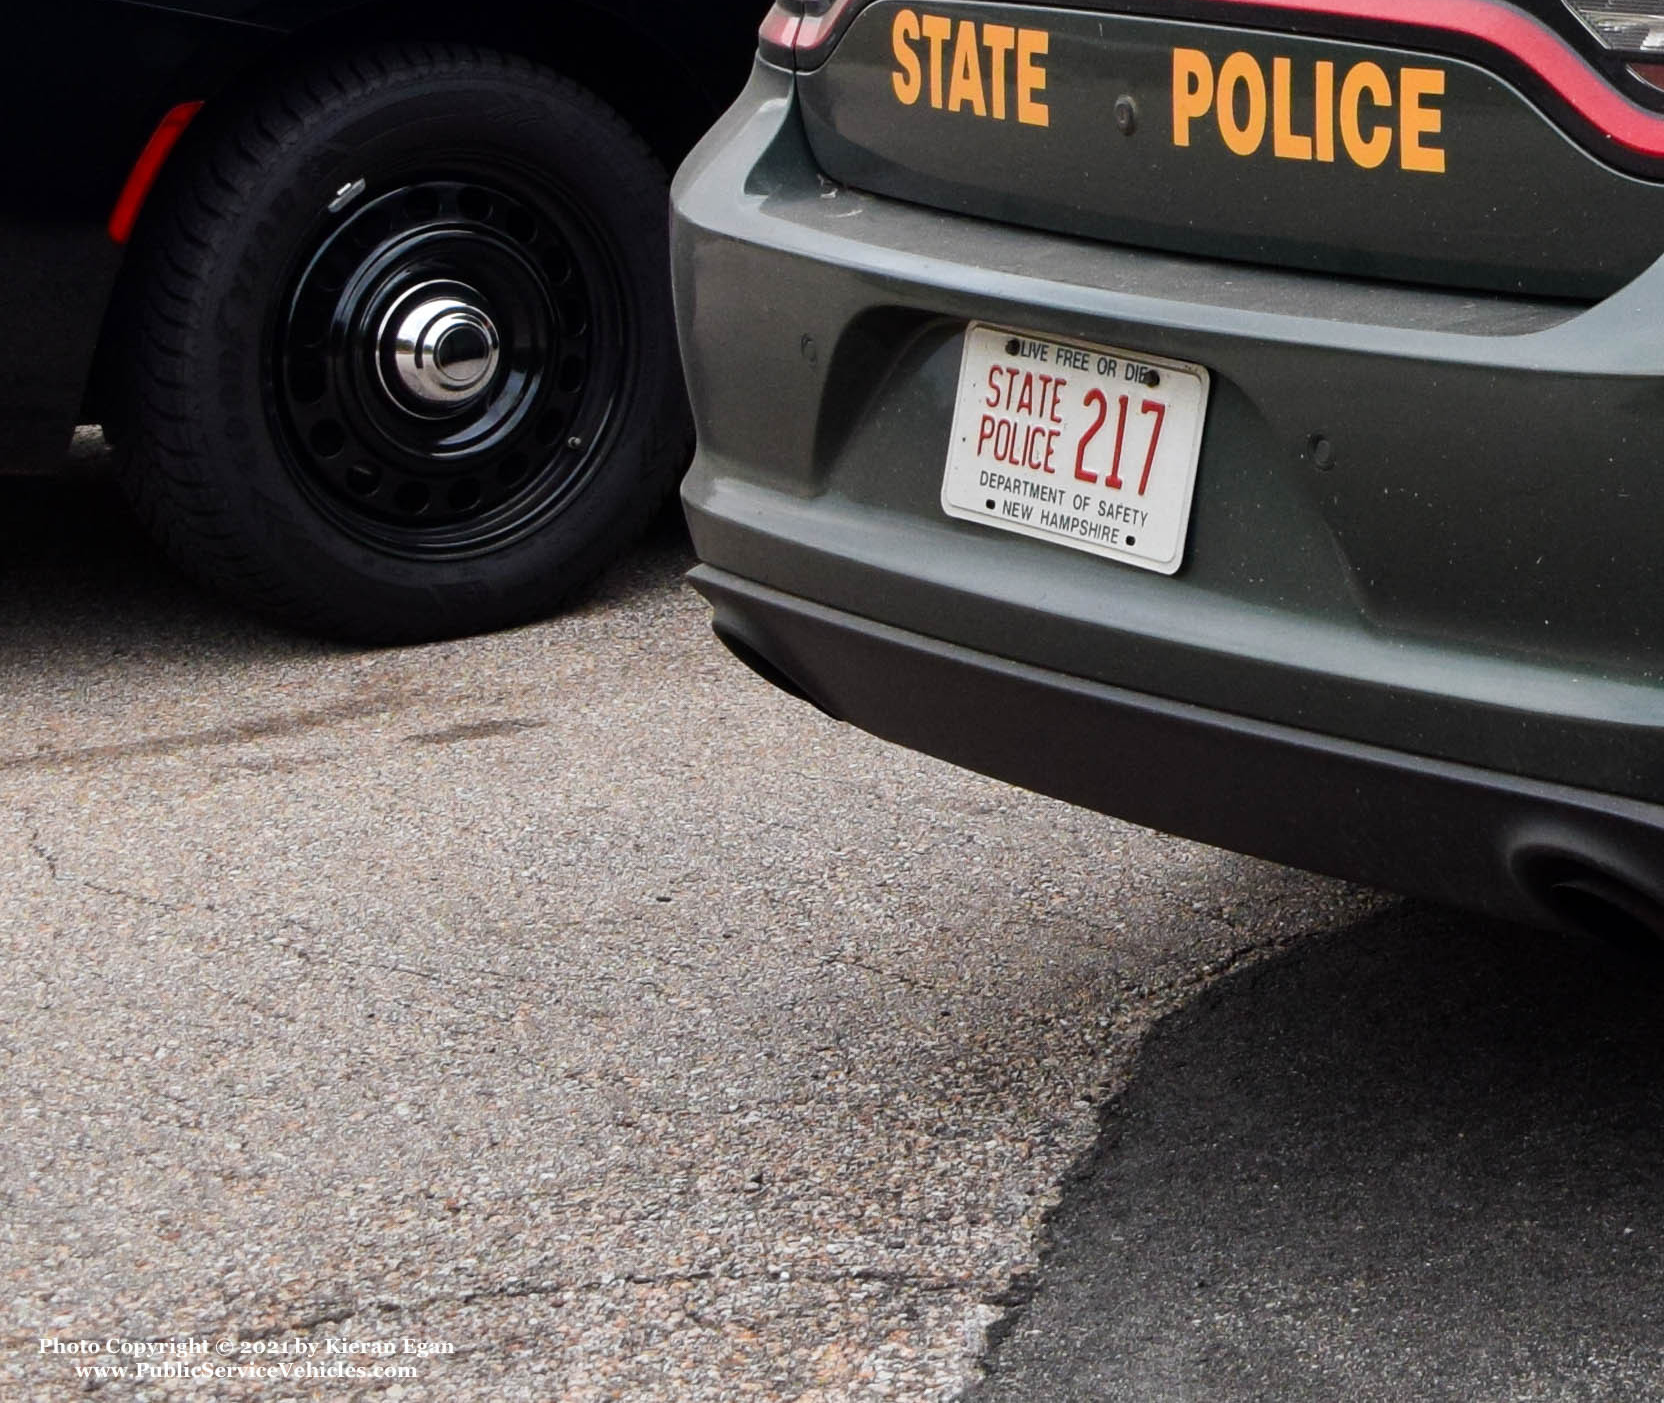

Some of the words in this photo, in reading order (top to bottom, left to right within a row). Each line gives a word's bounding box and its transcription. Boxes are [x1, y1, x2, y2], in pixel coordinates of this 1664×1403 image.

[891, 9, 1049, 127] STATE
[1173, 47, 1445, 173] POLICE
[1020, 340, 1048, 362] LIVE
[1055, 348, 1090, 371] FREE
[1097, 357, 1117, 378] OR
[1125, 363, 1150, 385] DIE
[986, 364, 1067, 423] STATE
[977, 413, 1061, 474] POLICE
[1074, 387, 1166, 496] 217
[980, 470, 1066, 507] DEPARTMENT
[1072, 493, 1091, 512] OF
[1097, 501, 1149, 528] SAFETY
[1002, 499, 1033, 521] NEW
[1040, 510, 1120, 545] HAMPSHIRE
